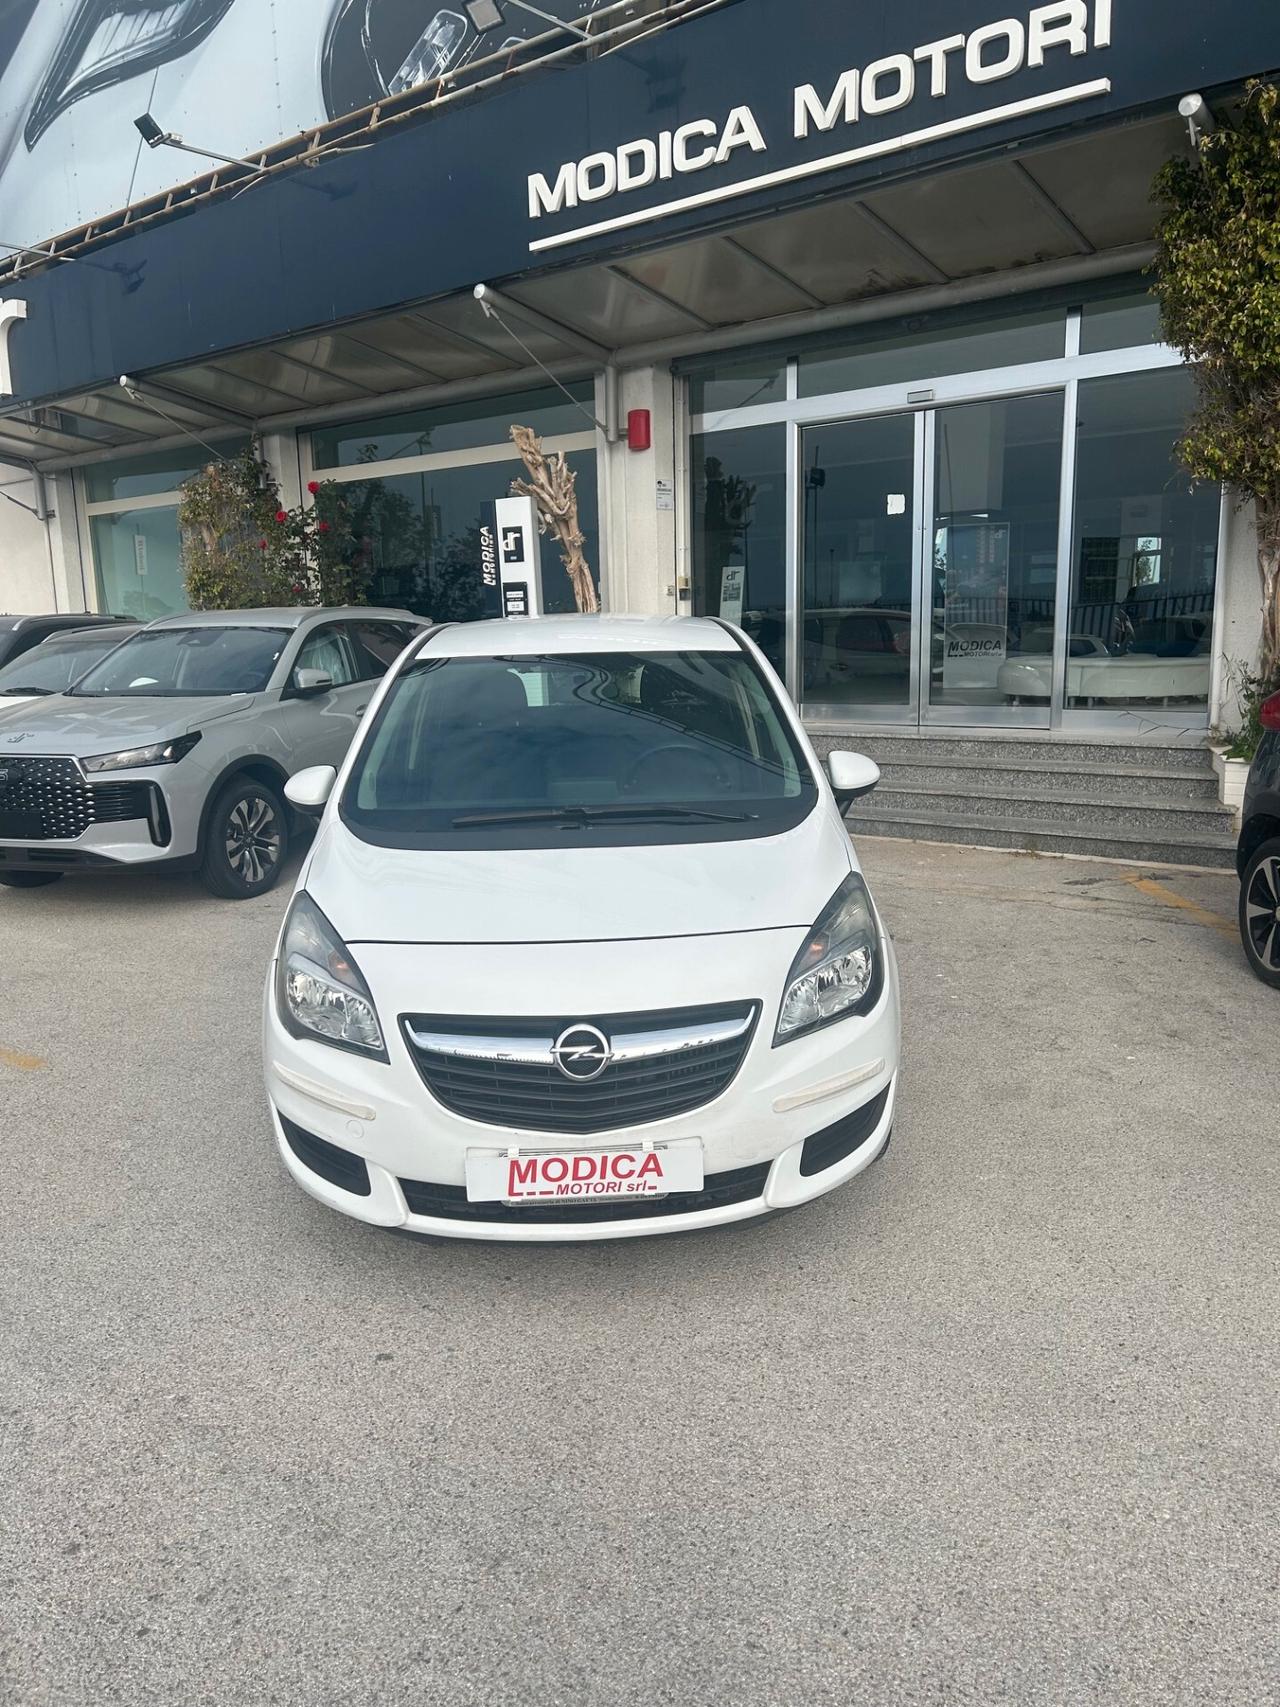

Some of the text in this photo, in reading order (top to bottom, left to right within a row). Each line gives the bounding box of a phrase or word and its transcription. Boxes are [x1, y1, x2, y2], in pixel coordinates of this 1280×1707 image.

[528, 0, 1111, 218] MODICA MOTORI
[480, 526, 494, 585] MODICA
[948, 640, 1002, 652] MODICA
[508, 1154, 663, 1184] MODICA
[556, 1180, 647, 1195] MOTORI srl
